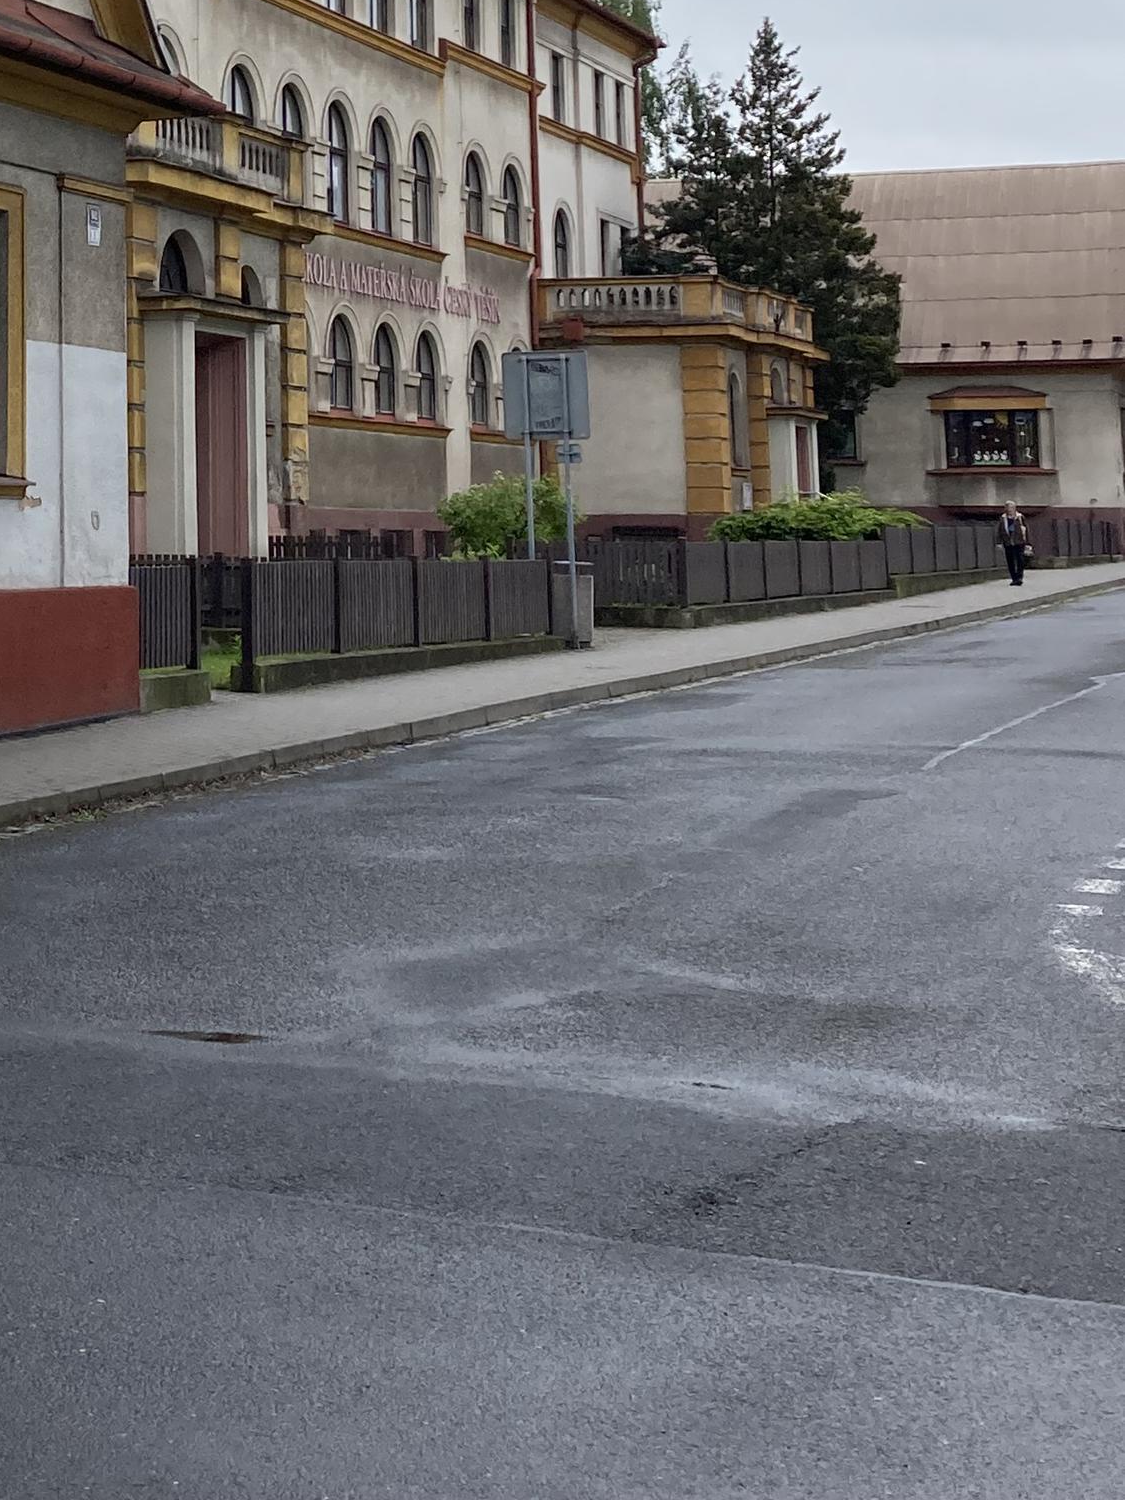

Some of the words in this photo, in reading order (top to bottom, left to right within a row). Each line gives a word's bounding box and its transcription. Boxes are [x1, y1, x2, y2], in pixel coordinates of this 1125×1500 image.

[339, 260, 348, 291] A
[350, 261, 406, 304] MATEŘSKÁ
[409, 267, 441, 310] ŠKOLA
